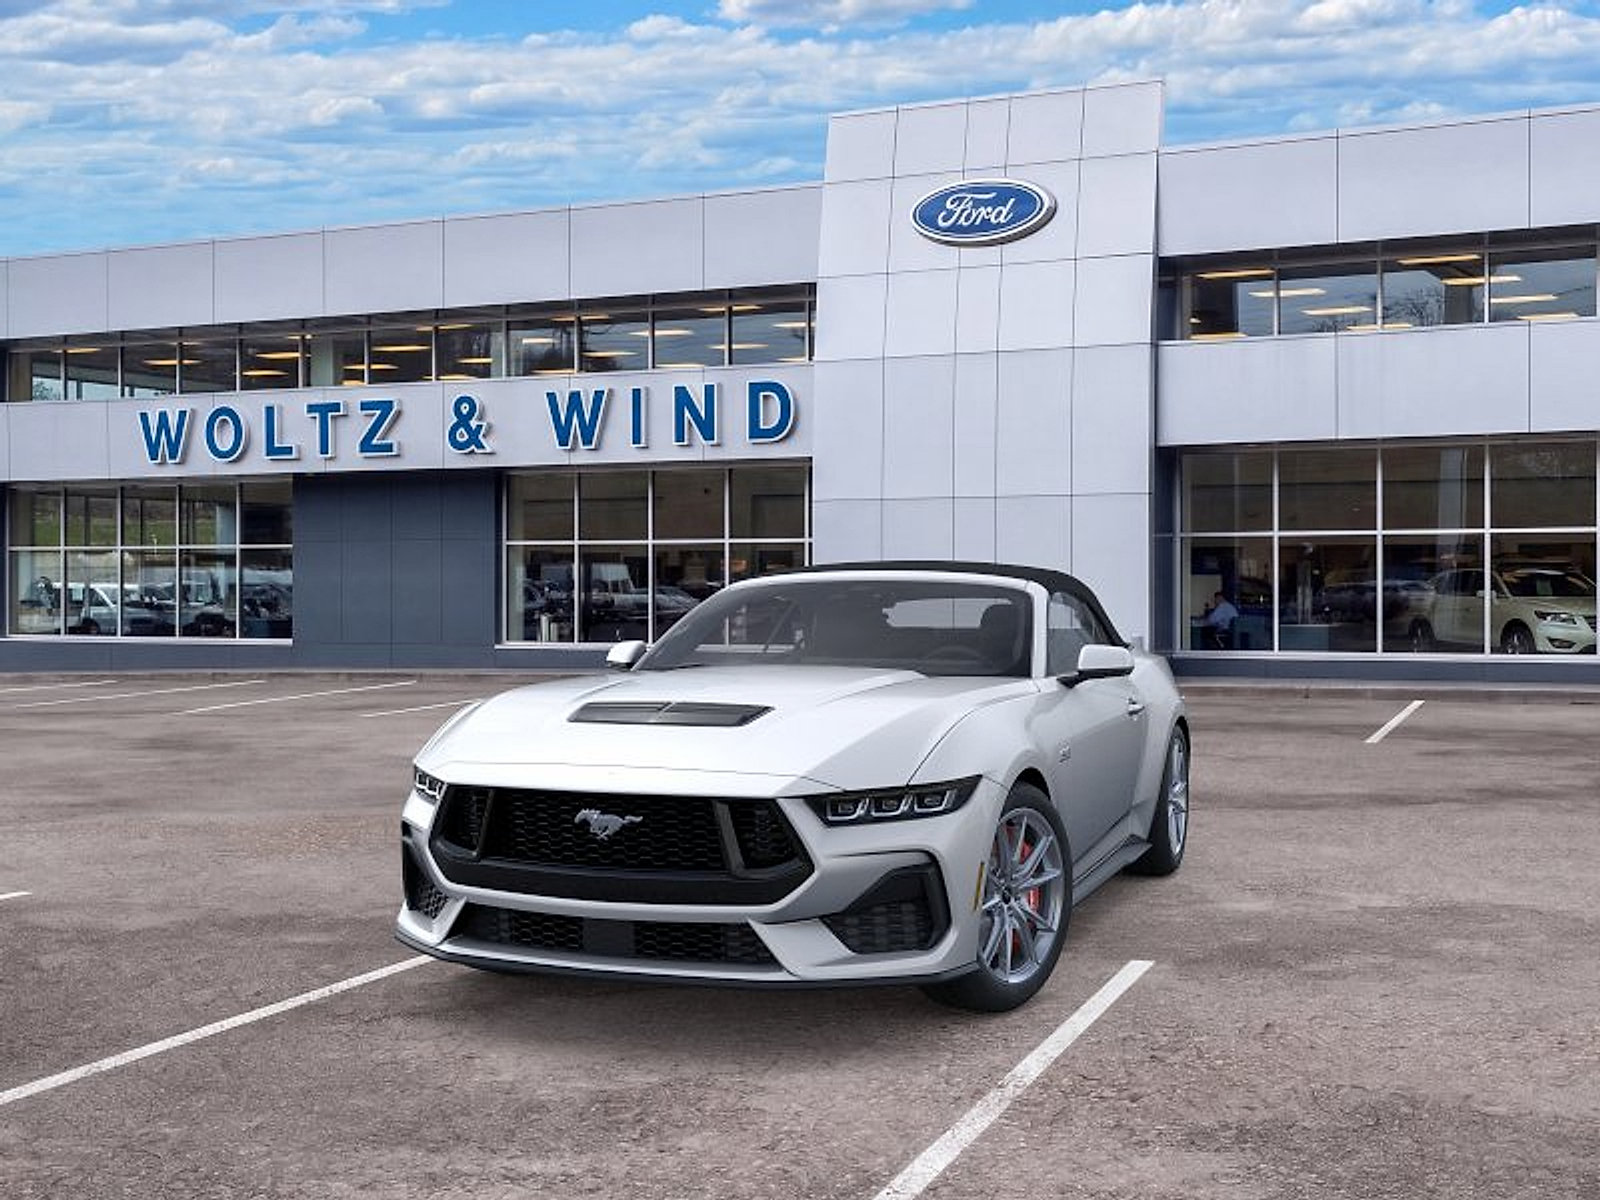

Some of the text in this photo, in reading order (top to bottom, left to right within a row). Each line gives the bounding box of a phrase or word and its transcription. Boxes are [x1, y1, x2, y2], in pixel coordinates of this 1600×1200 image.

[937, 192, 1015, 228] Ford
[139, 379, 796, 464] WOLTZ & WIND
